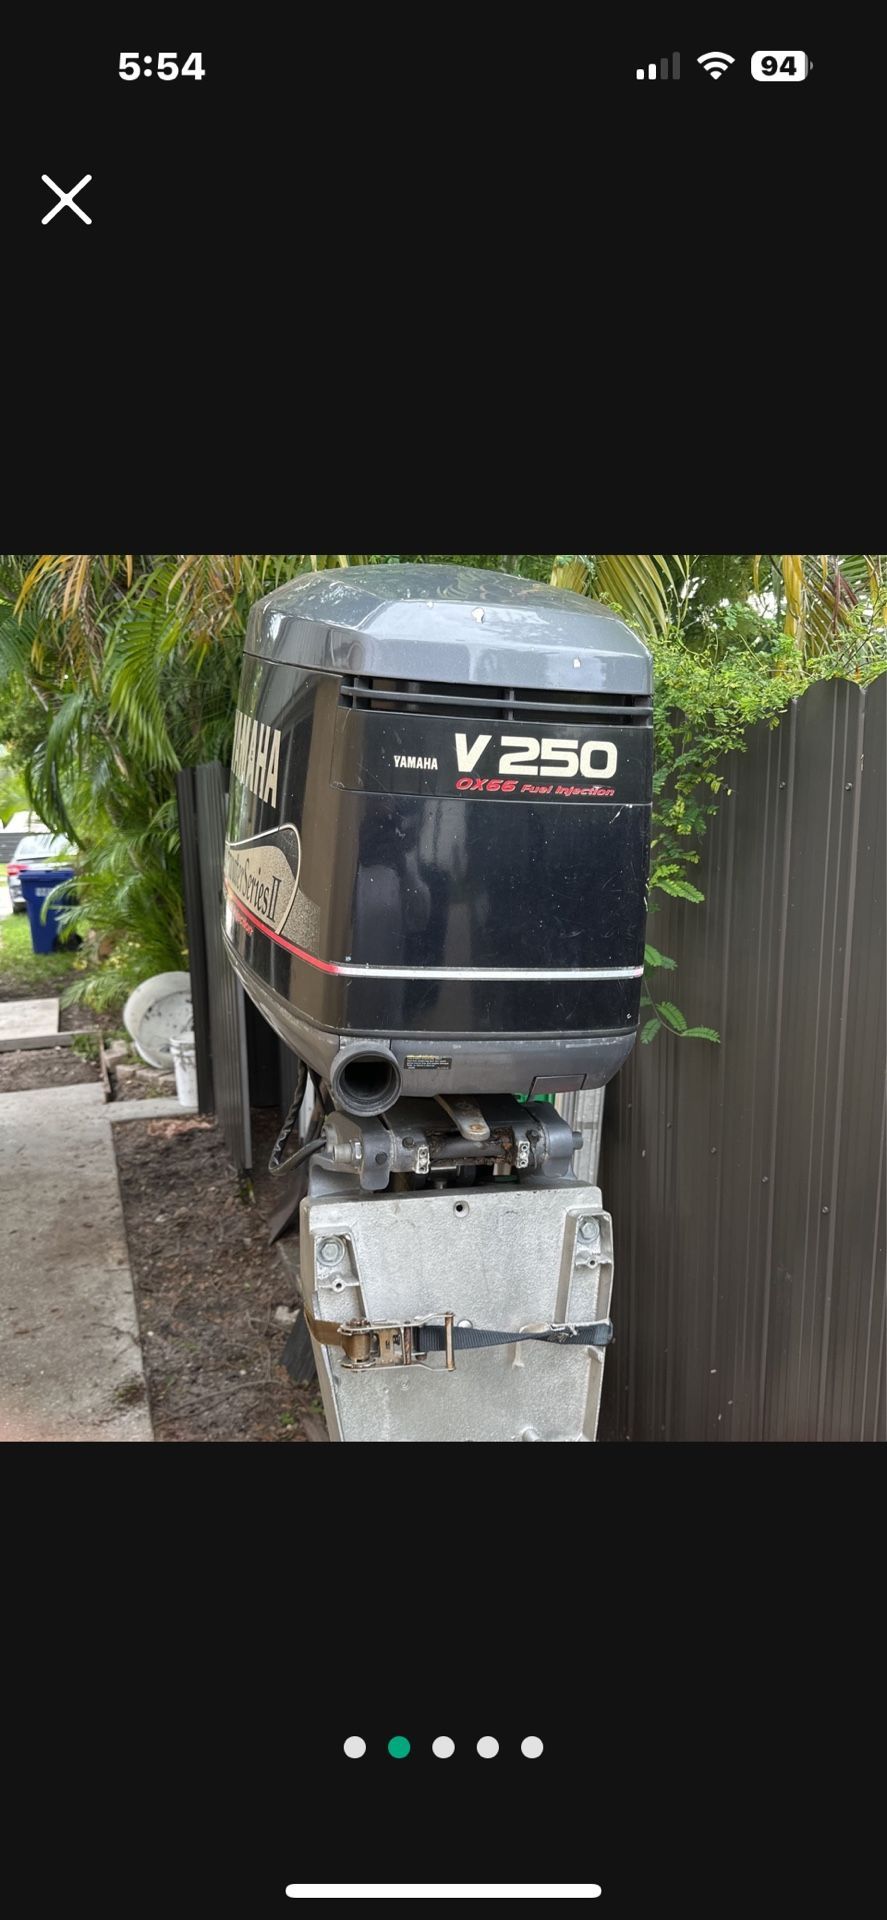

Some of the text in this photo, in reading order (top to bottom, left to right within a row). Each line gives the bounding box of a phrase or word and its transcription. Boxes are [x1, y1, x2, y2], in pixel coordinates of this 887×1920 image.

[393, 755, 439, 771] YAMAHA
[499, 735, 618, 779] 250
[455, 777, 616, 797] OX66 Fuel Injection
